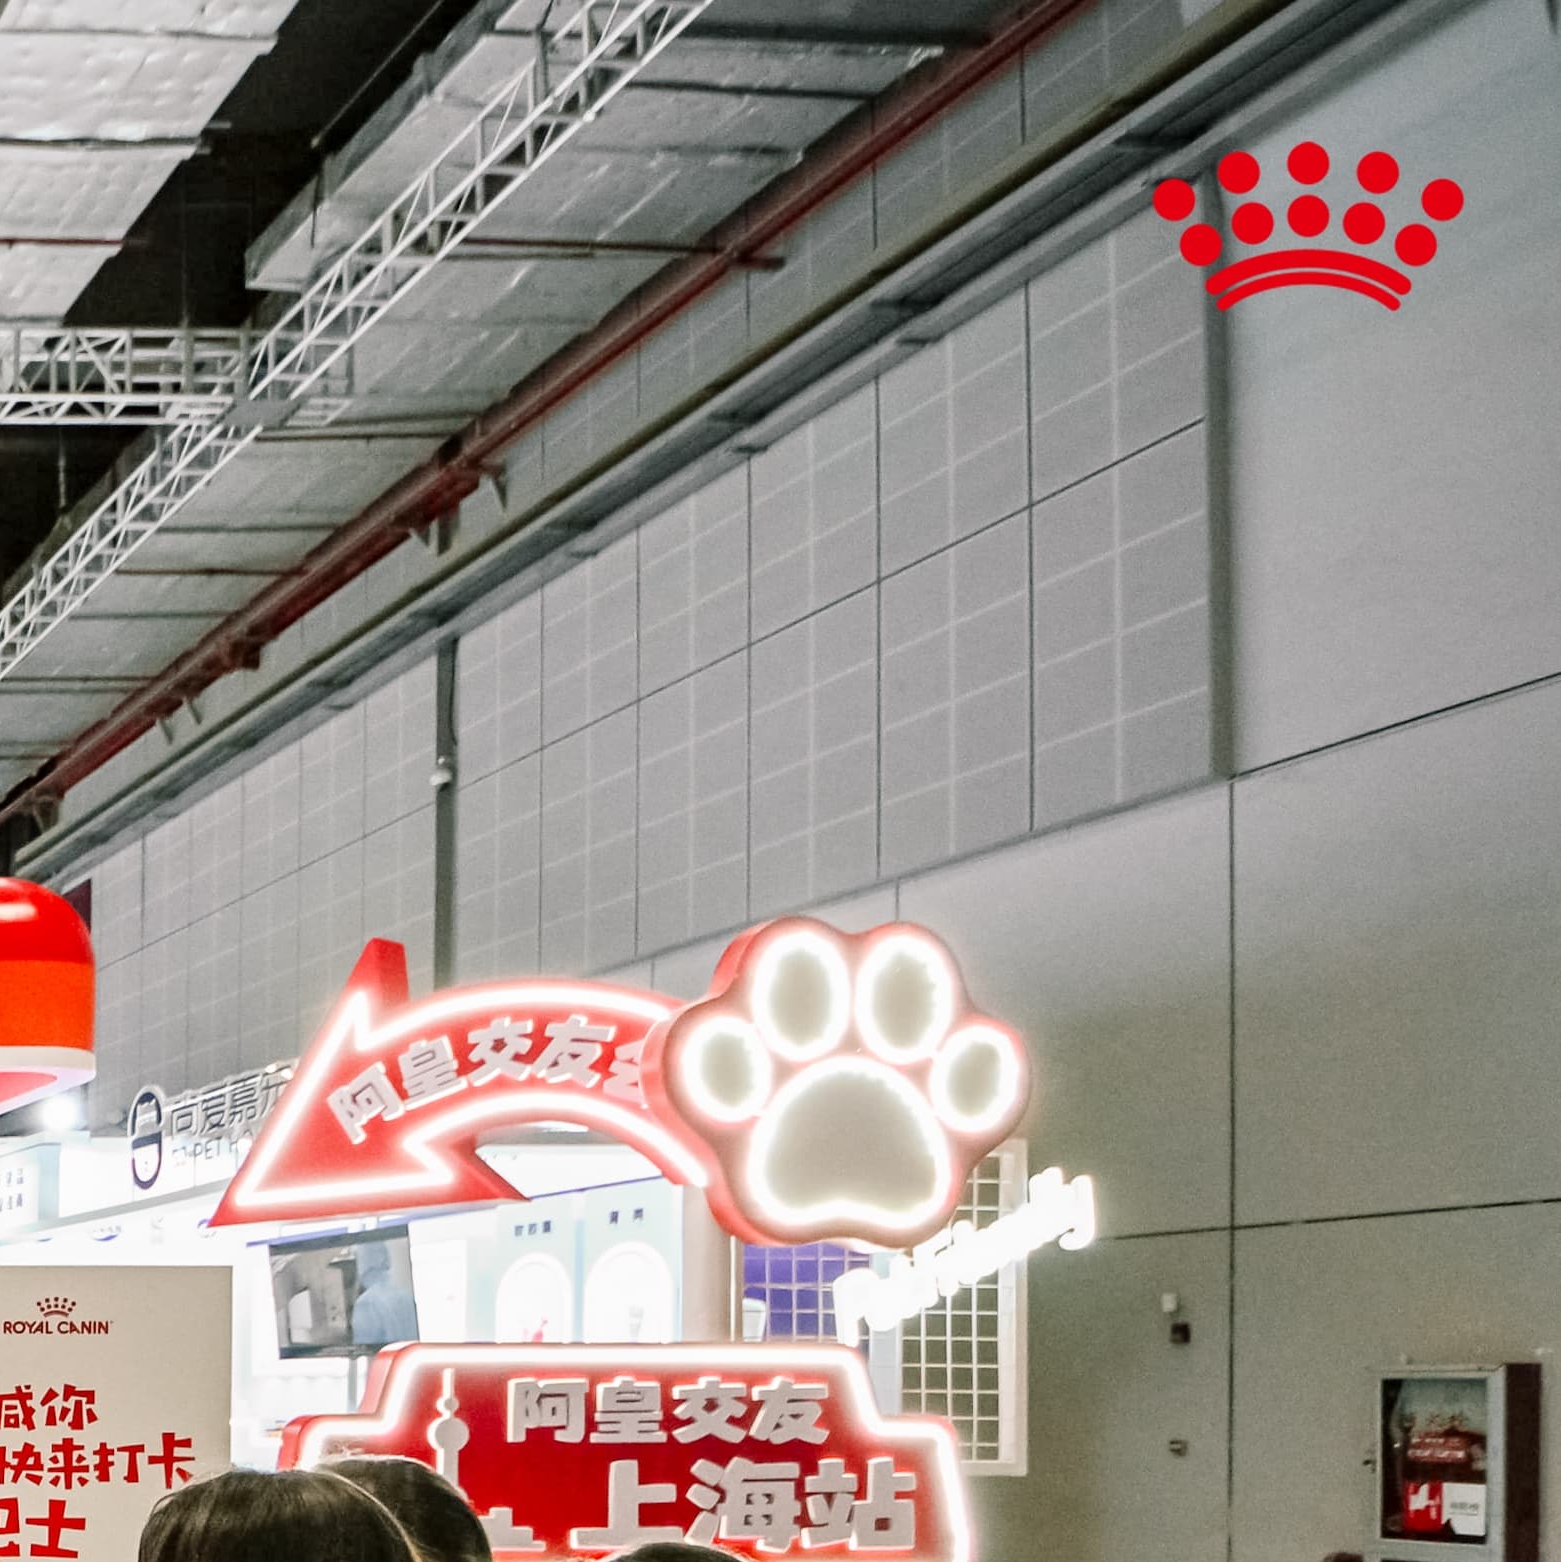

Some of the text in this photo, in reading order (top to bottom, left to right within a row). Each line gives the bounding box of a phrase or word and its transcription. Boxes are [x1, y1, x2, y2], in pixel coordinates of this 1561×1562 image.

[3, 1320, 109, 1334] ROYAL CANIN
[507, 1377, 830, 1444] 阿皇交友
[570, 1458, 916, 1552] 上海站
